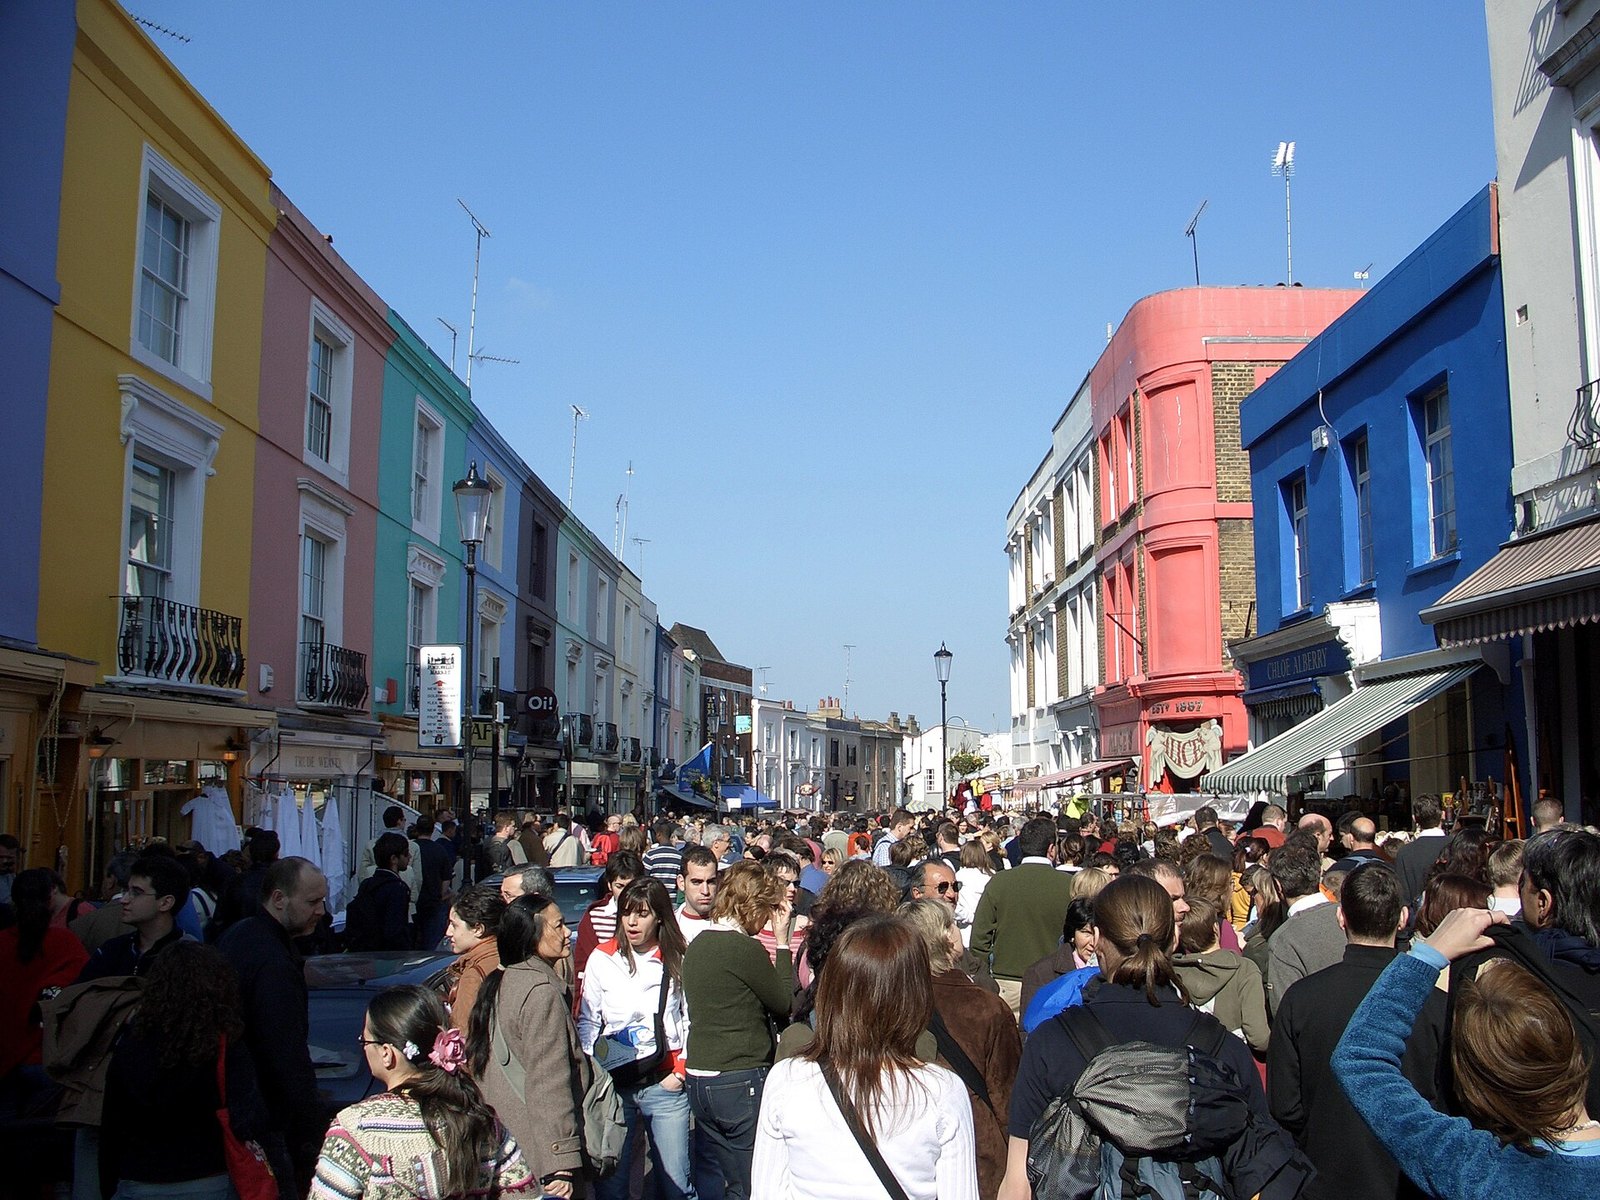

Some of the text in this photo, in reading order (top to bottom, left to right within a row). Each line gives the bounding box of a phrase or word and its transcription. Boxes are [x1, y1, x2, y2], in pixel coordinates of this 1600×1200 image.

[1267, 647, 1328, 680] CHLOE ALBERRY
[528, 696, 553, 710] Oi!
